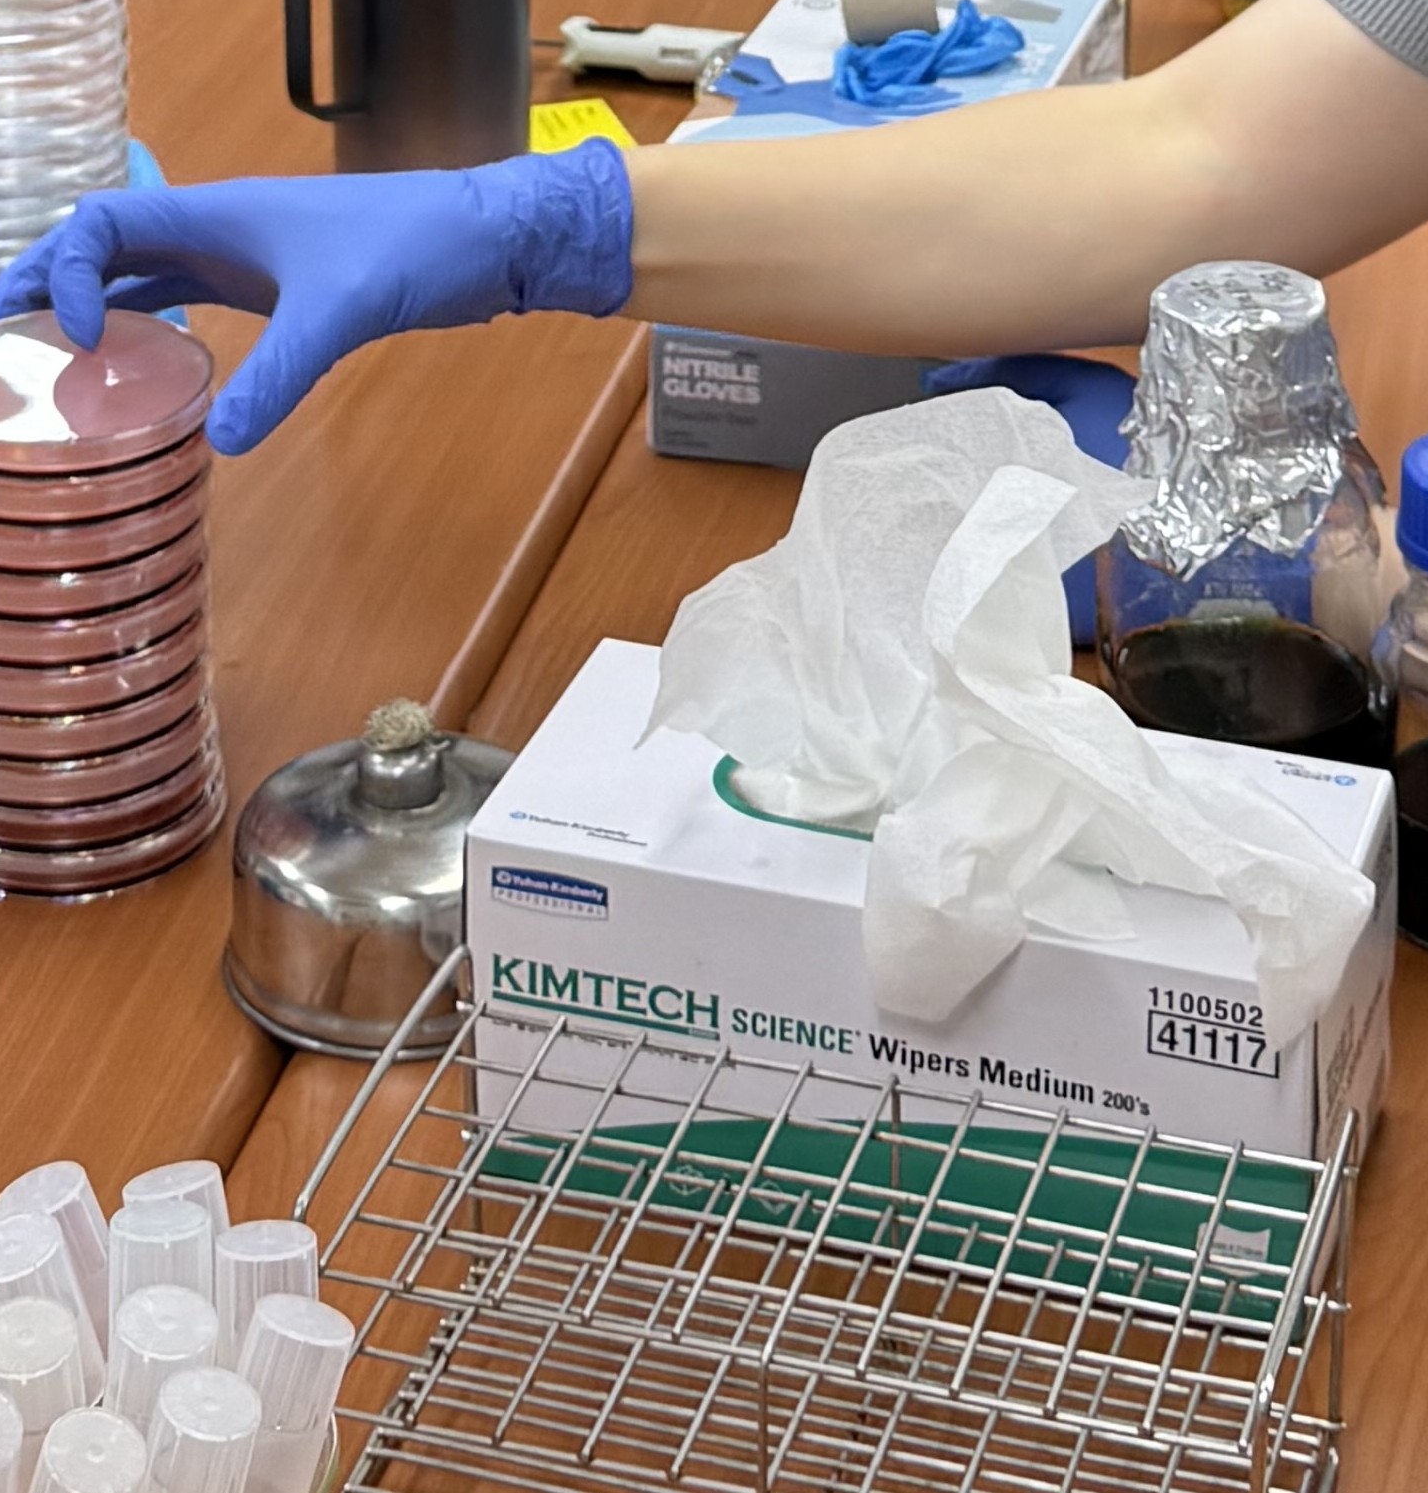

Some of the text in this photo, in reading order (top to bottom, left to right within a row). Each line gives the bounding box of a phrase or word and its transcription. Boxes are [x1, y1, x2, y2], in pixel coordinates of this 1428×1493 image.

[663, 356, 761, 383] NITRILE
[663, 378, 761, 404] GLOVES
[1148, 986, 1264, 1027] 1100502
[492, 953, 720, 1029] KIMTECH
[870, 1033, 971, 1077] Wipers
[979, 1056, 1094, 1104] Medium
[1102, 1090, 1151, 1116] 200's
[1157, 1019, 1267, 1068] 41117
